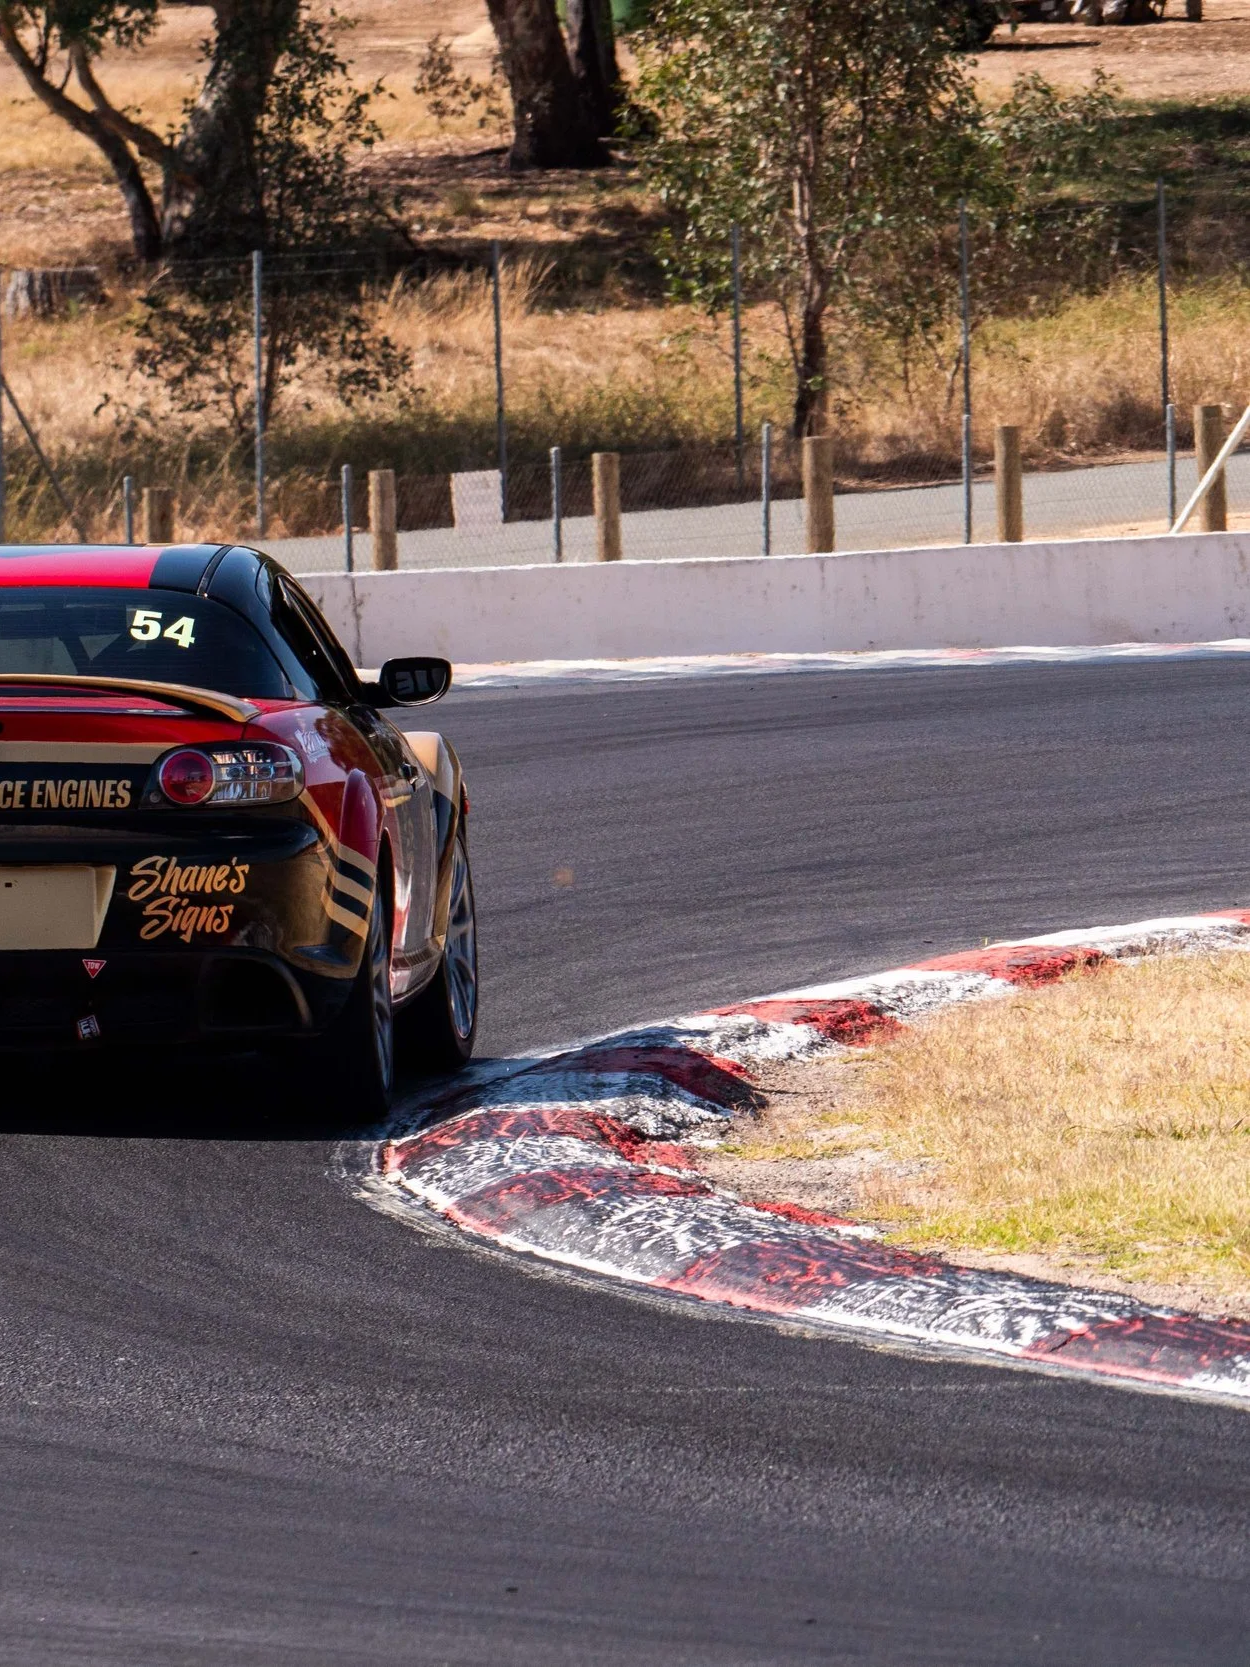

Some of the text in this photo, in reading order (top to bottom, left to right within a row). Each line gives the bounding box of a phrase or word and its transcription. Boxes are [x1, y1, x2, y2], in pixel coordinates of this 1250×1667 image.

[130, 609, 195, 648] 54
[30, 779, 132, 809] ENGINES
[128, 855, 250, 901] Shane's
[140, 895, 234, 943] Signs
